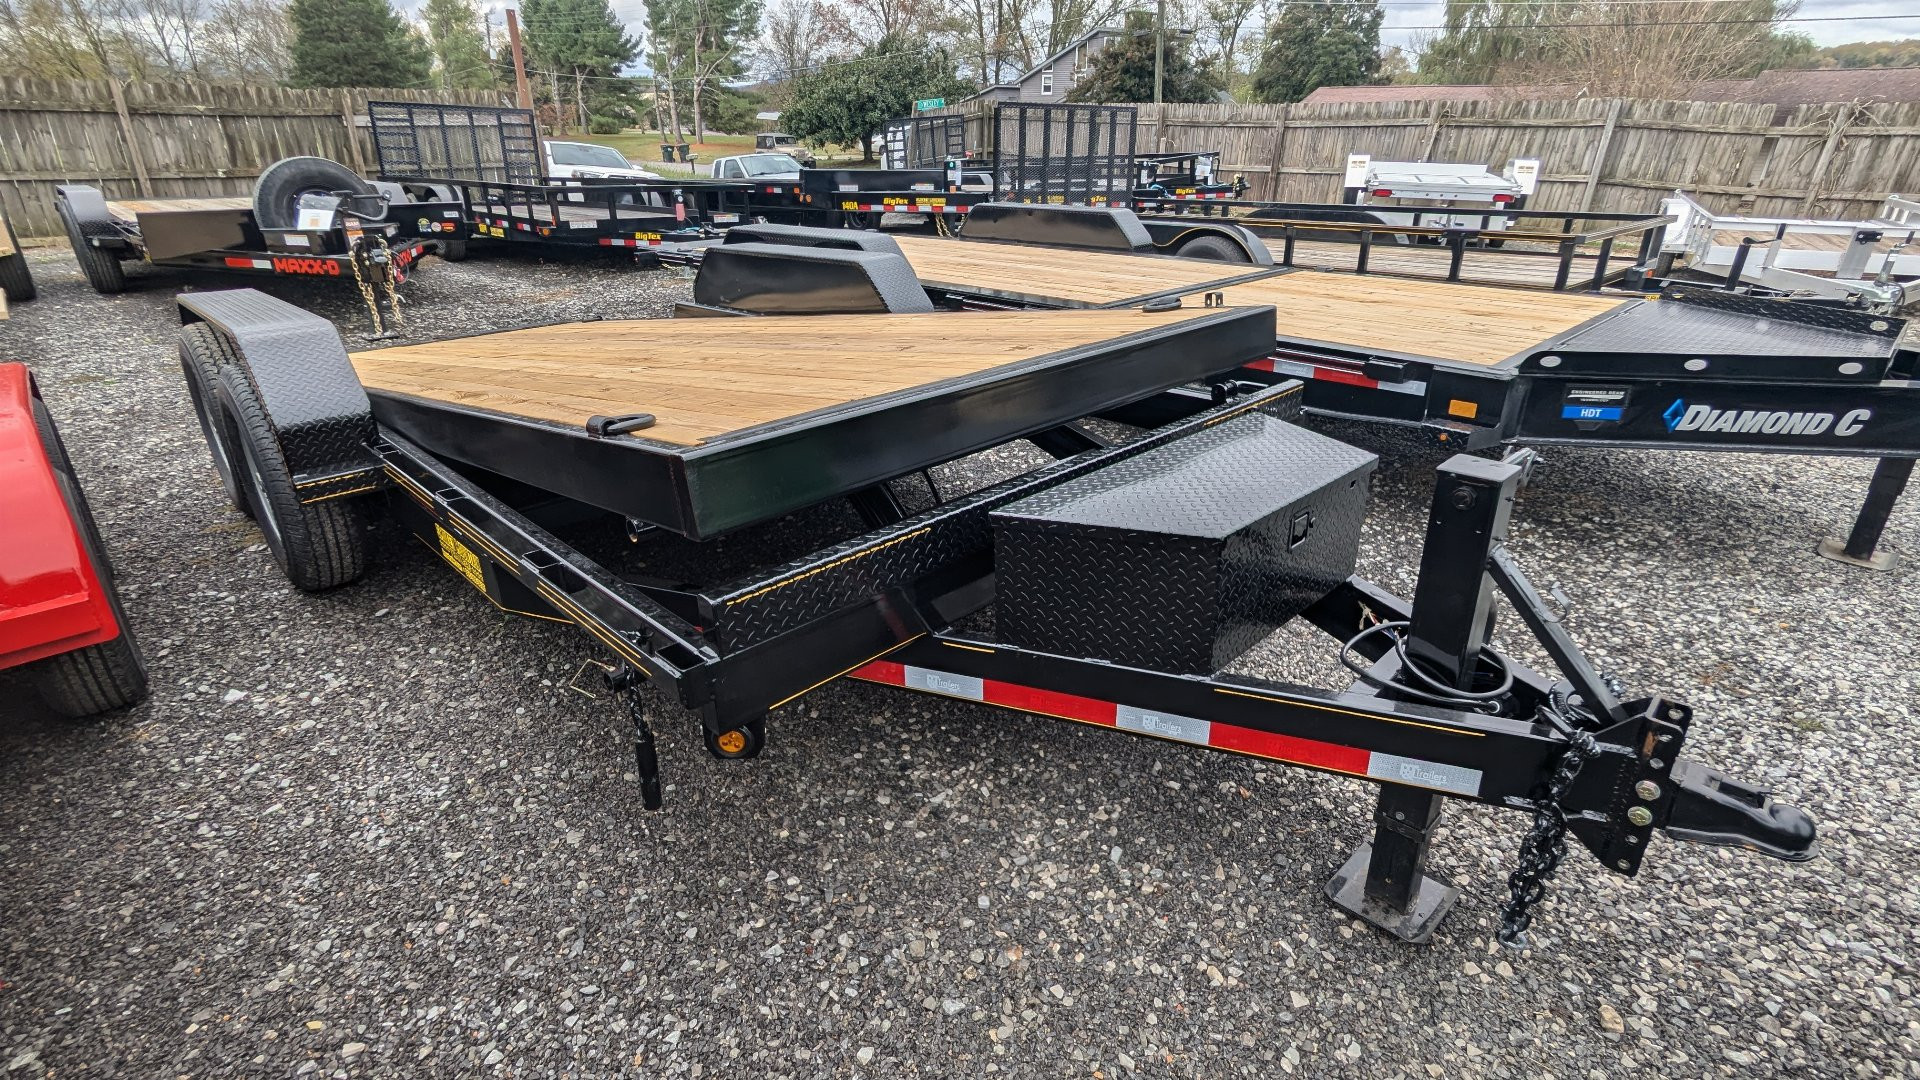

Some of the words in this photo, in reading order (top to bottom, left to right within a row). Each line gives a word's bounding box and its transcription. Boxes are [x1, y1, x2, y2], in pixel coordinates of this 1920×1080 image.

[842, 201, 859, 210] 140A
[883, 198, 909, 206] BigTex
[635, 231, 662, 241] BigTex
[273, 257, 340, 276] MAXX-D
[1580, 409, 1603, 418] HDT
[1834, 409, 1871, 437] C
[1156, 719, 1182, 733] Trailers
[1416, 768, 1447, 782] Trailers
